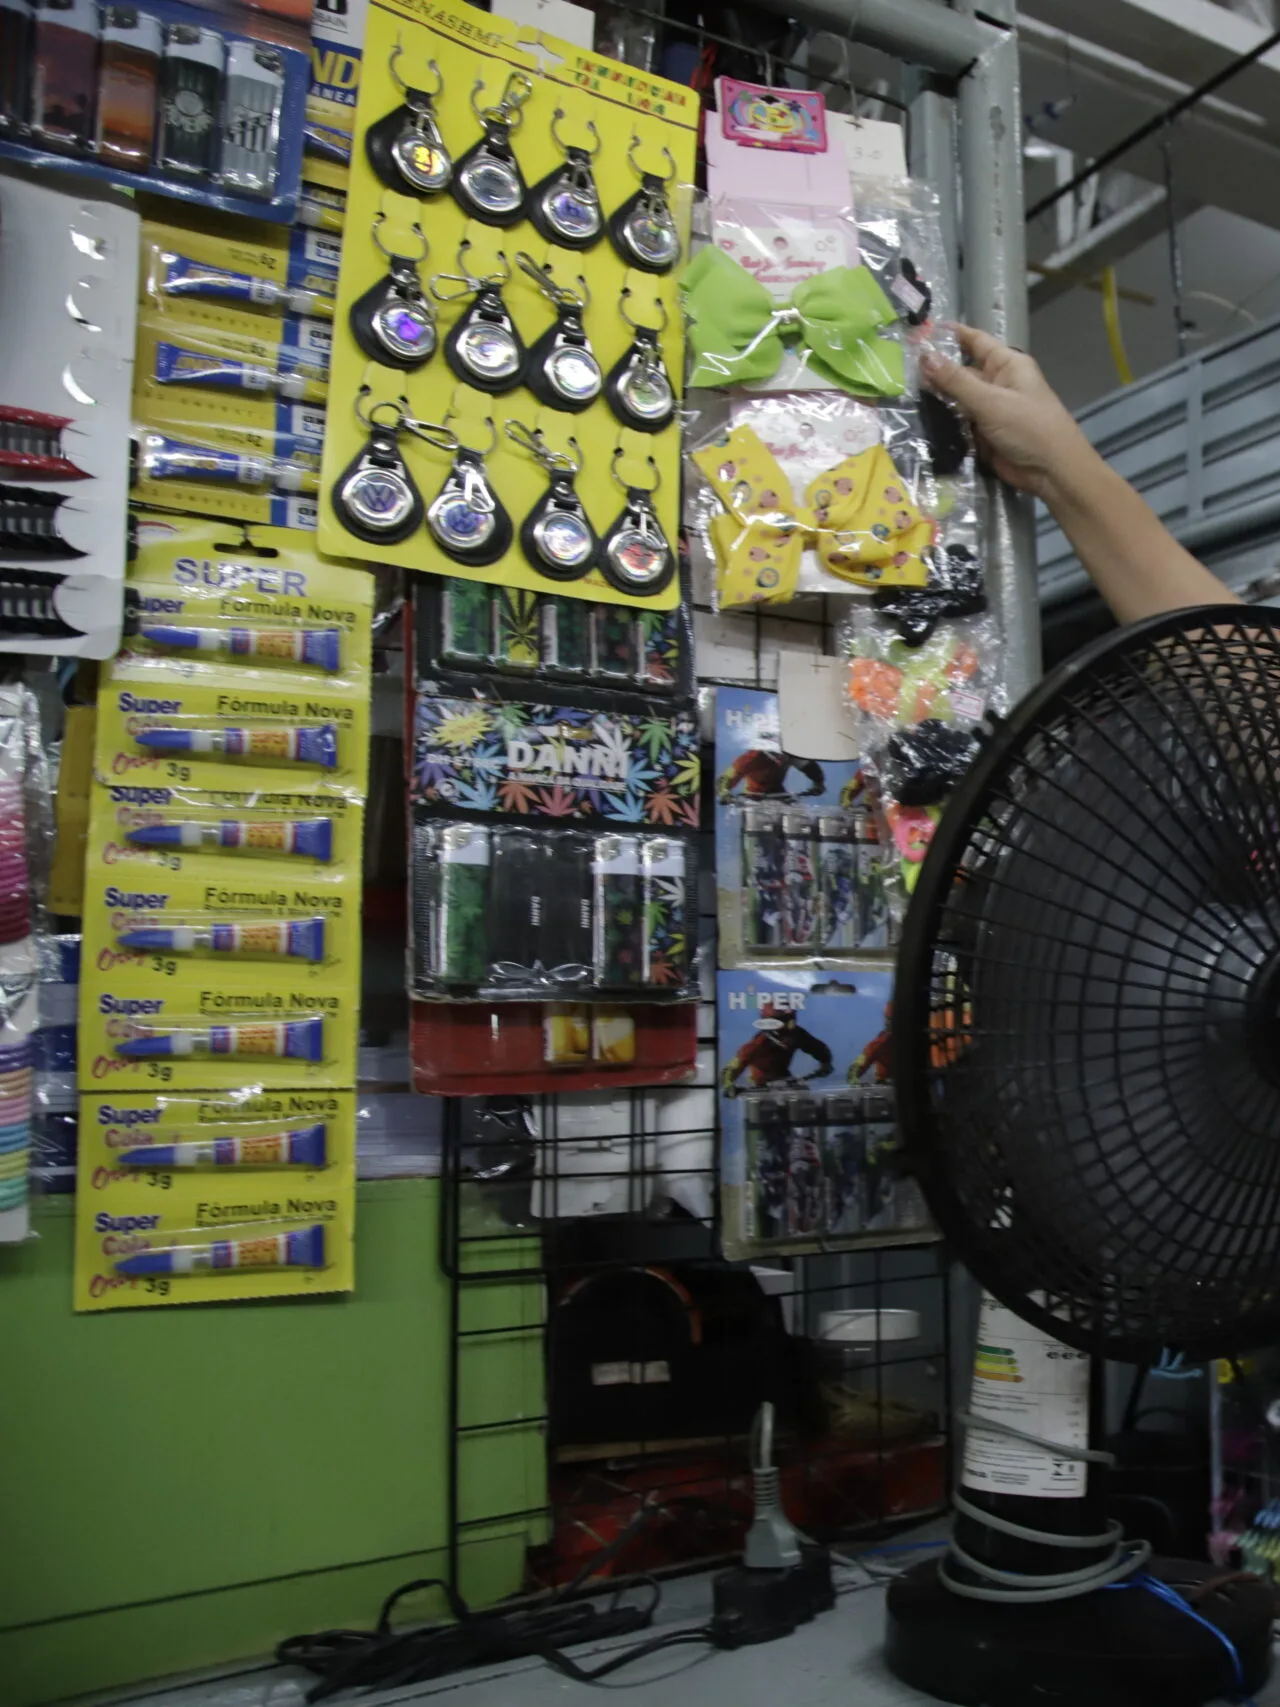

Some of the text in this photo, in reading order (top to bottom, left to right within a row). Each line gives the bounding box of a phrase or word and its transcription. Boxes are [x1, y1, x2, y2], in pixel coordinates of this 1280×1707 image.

[174, 558, 310, 598] SUPER
[138, 596, 184, 615] uper
[308, 604, 356, 623] Nova
[118, 692, 183, 716] Super
[305, 702, 354, 720] Nova
[166, 762, 191, 781] 3g
[104, 887, 170, 911] Super
[294, 891, 343, 909] Nova
[151, 955, 177, 976] 3g
[98, 993, 164, 1017] Super
[289, 992, 340, 1009] Nova
[147, 1062, 173, 1081] 3g
[288, 1095, 339, 1112] Nova
[98, 1104, 164, 1128] Super
[147, 1172, 173, 1190] 3g
[286, 1198, 337, 1214] Nova
[95, 1212, 161, 1236] Super
[145, 1276, 170, 1296] 3g
